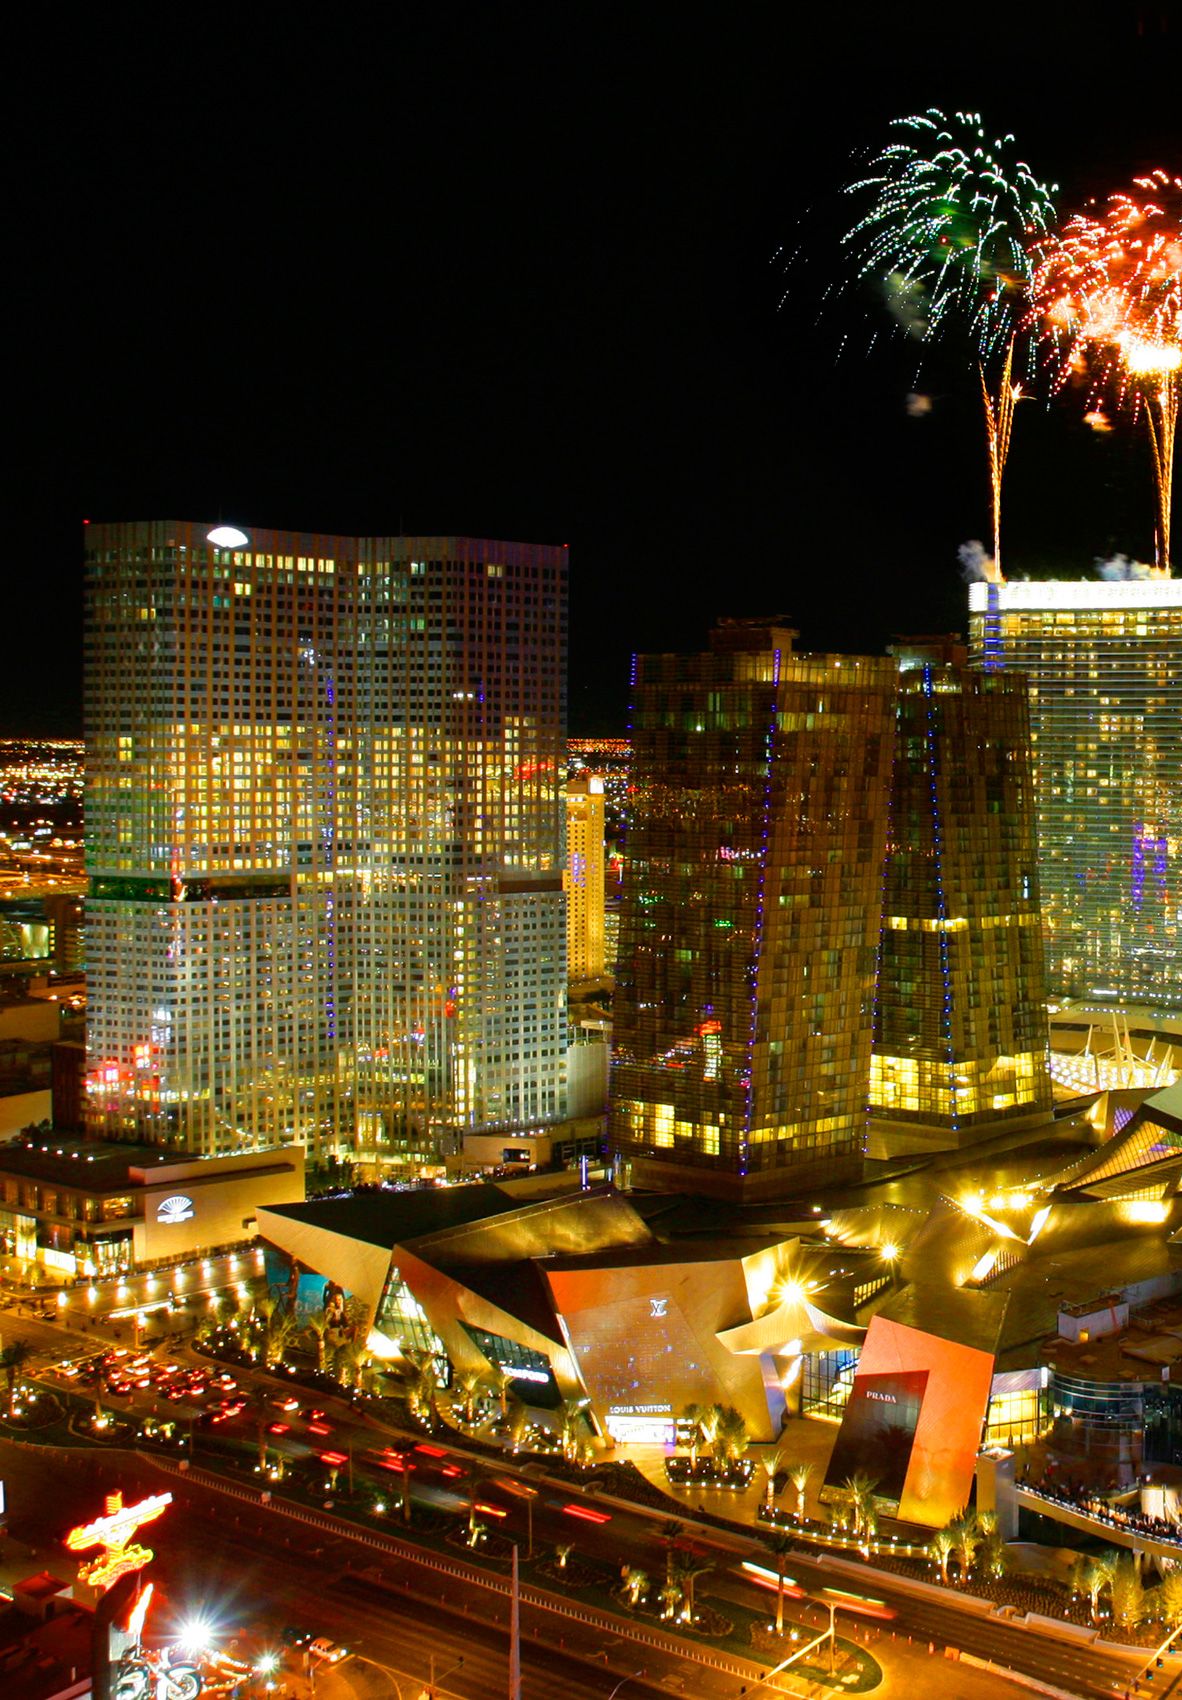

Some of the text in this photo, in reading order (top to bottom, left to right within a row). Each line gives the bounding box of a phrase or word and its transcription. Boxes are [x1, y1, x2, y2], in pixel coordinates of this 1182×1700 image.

[866, 1390, 897, 1404] PRADA
[609, 1404, 672, 1414] LOUIS VUITTON
